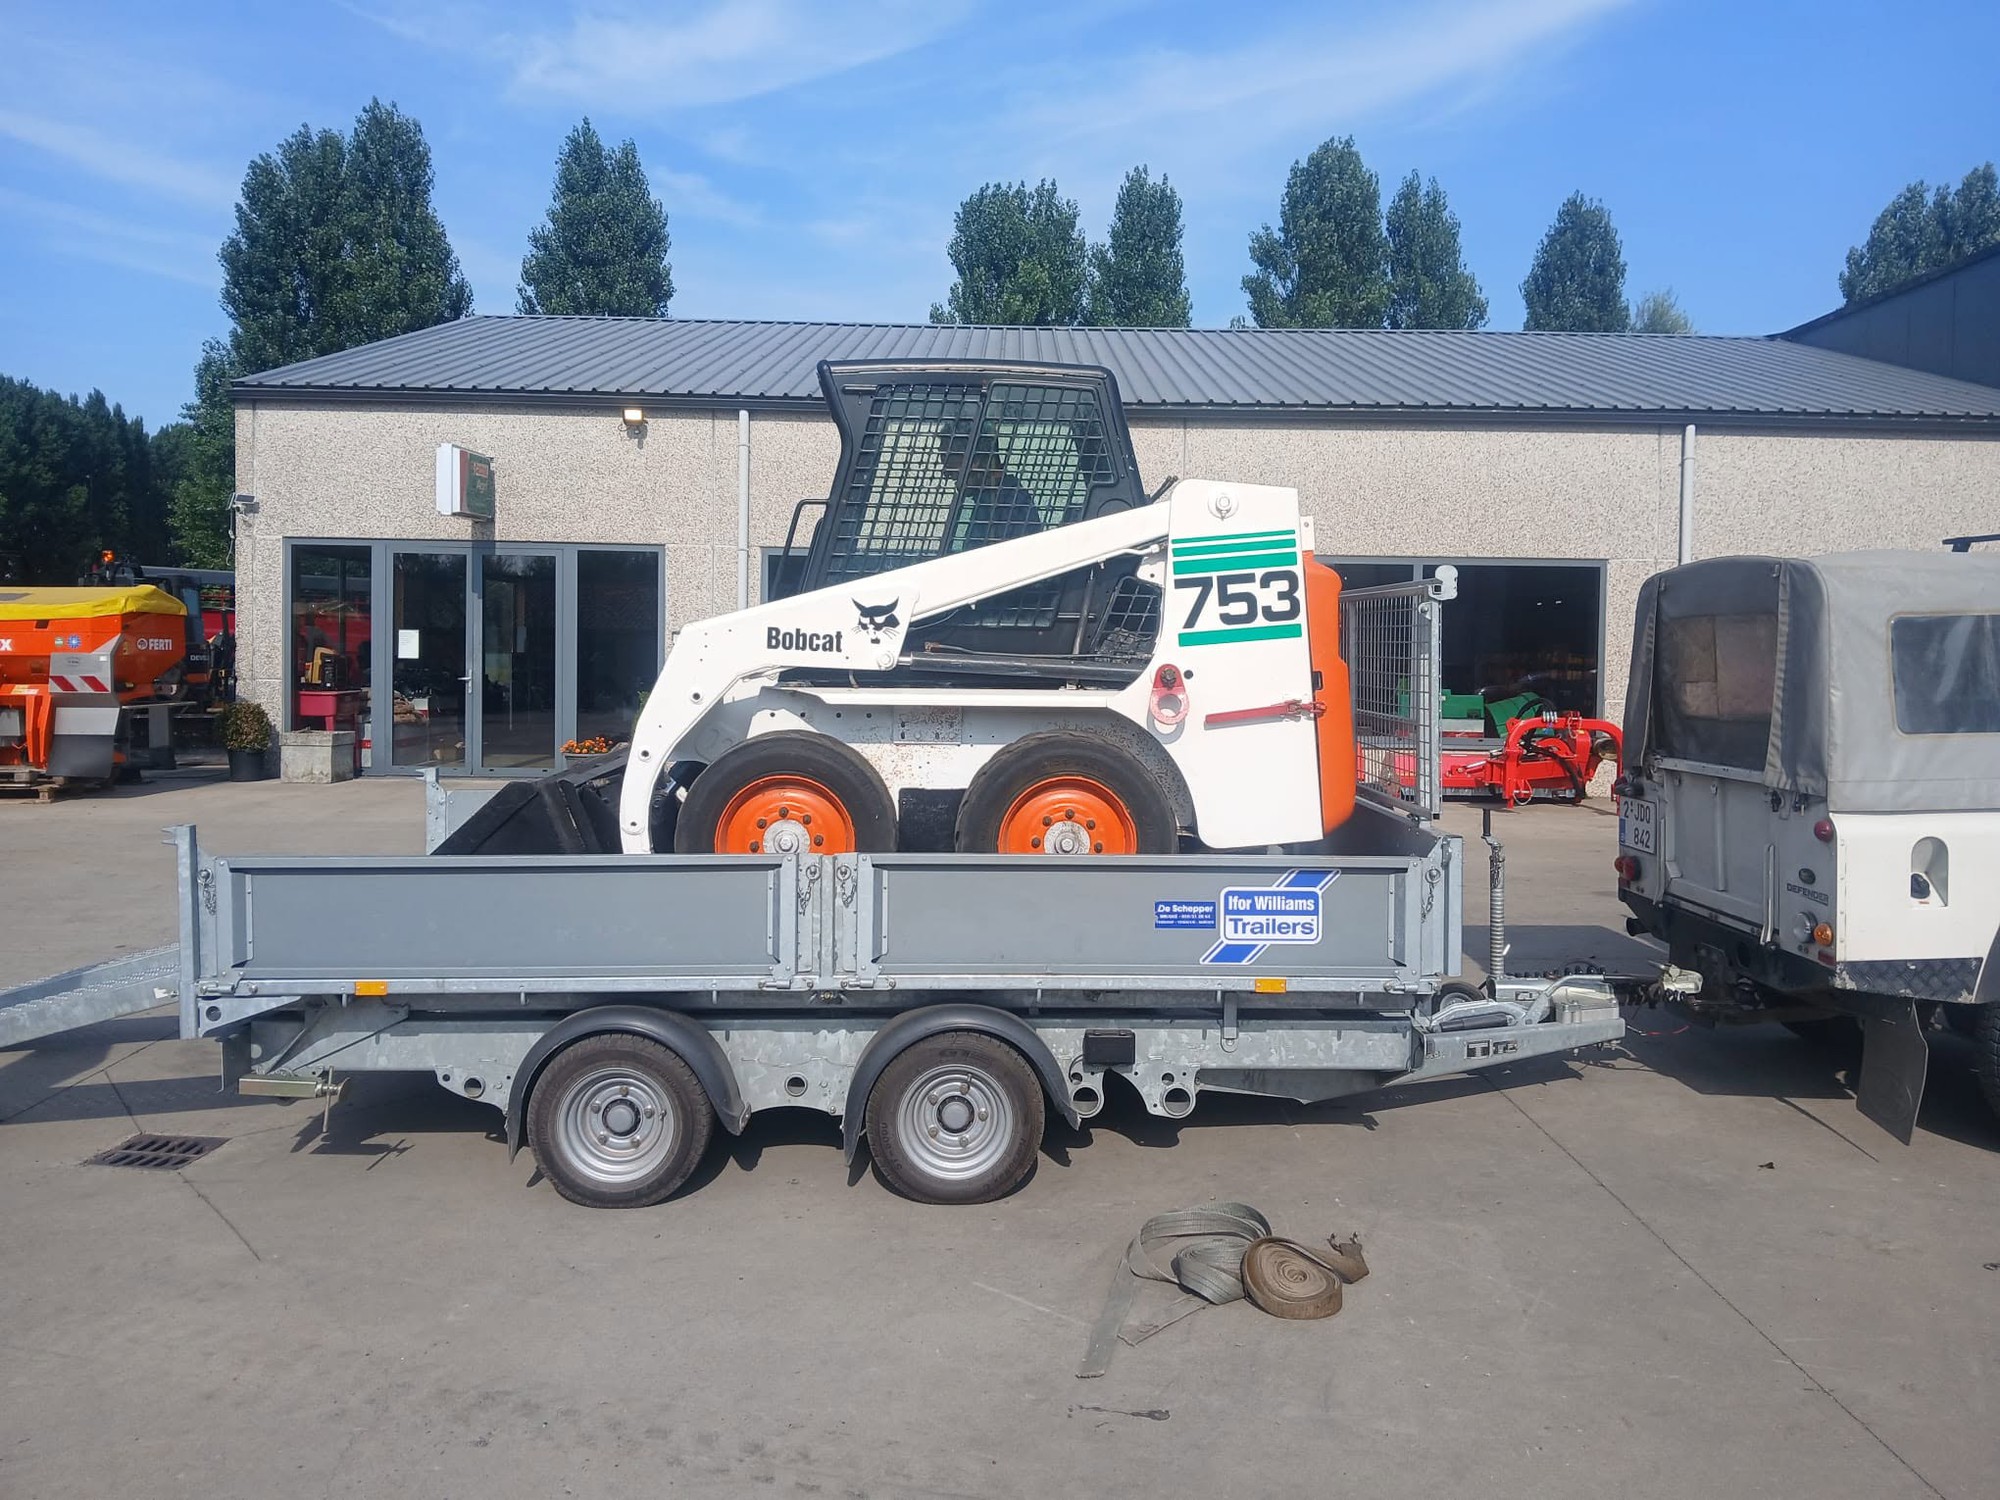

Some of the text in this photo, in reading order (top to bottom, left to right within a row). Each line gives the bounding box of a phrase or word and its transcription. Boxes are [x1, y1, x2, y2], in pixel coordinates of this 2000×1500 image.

[1174, 570, 1300, 629] 753
[148, 638, 173, 650] FERTI
[767, 626, 842, 653] Bobcat
[1633, 827, 1651, 850] 842
[1786, 882, 1829, 904] DEFENDER
[1157, 904, 1214, 914] De Schepper
[1228, 895, 1315, 912] Ifor Williams
[1228, 917, 1315, 936] Trailers
